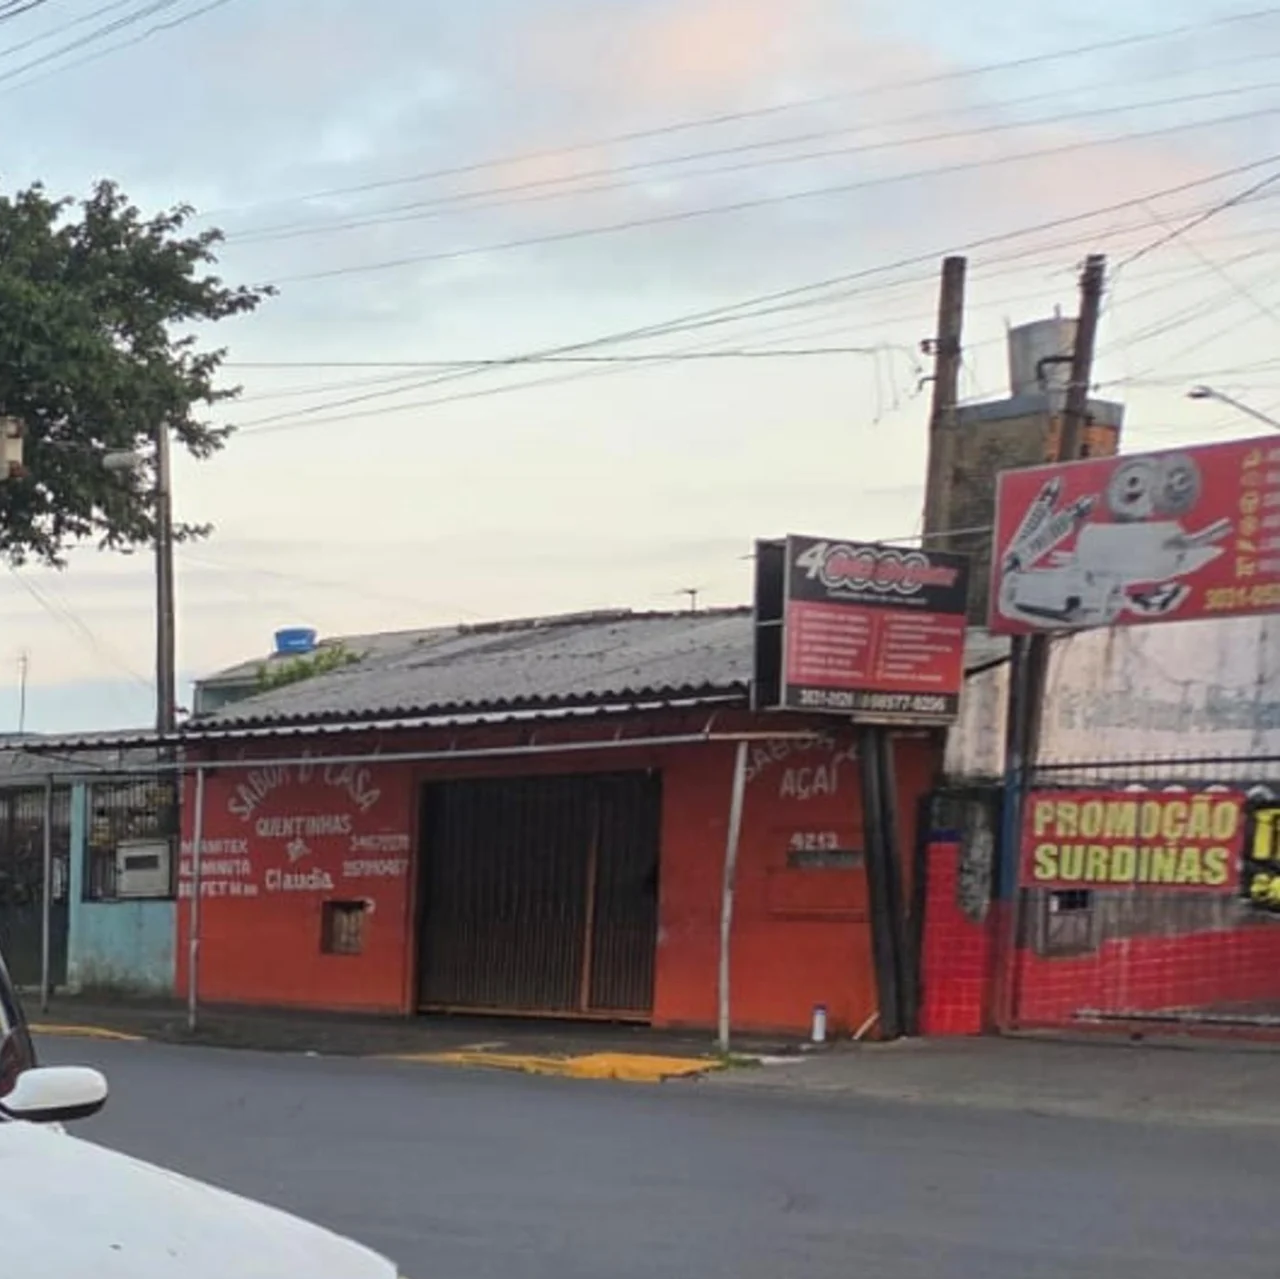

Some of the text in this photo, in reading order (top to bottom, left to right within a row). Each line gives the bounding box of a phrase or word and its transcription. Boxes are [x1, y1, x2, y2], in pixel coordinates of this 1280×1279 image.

[1033, 794, 1239, 846] PROMOÇÃO
[265, 867, 335, 891] Claudia
[1033, 844, 1229, 885] SURDINAS
